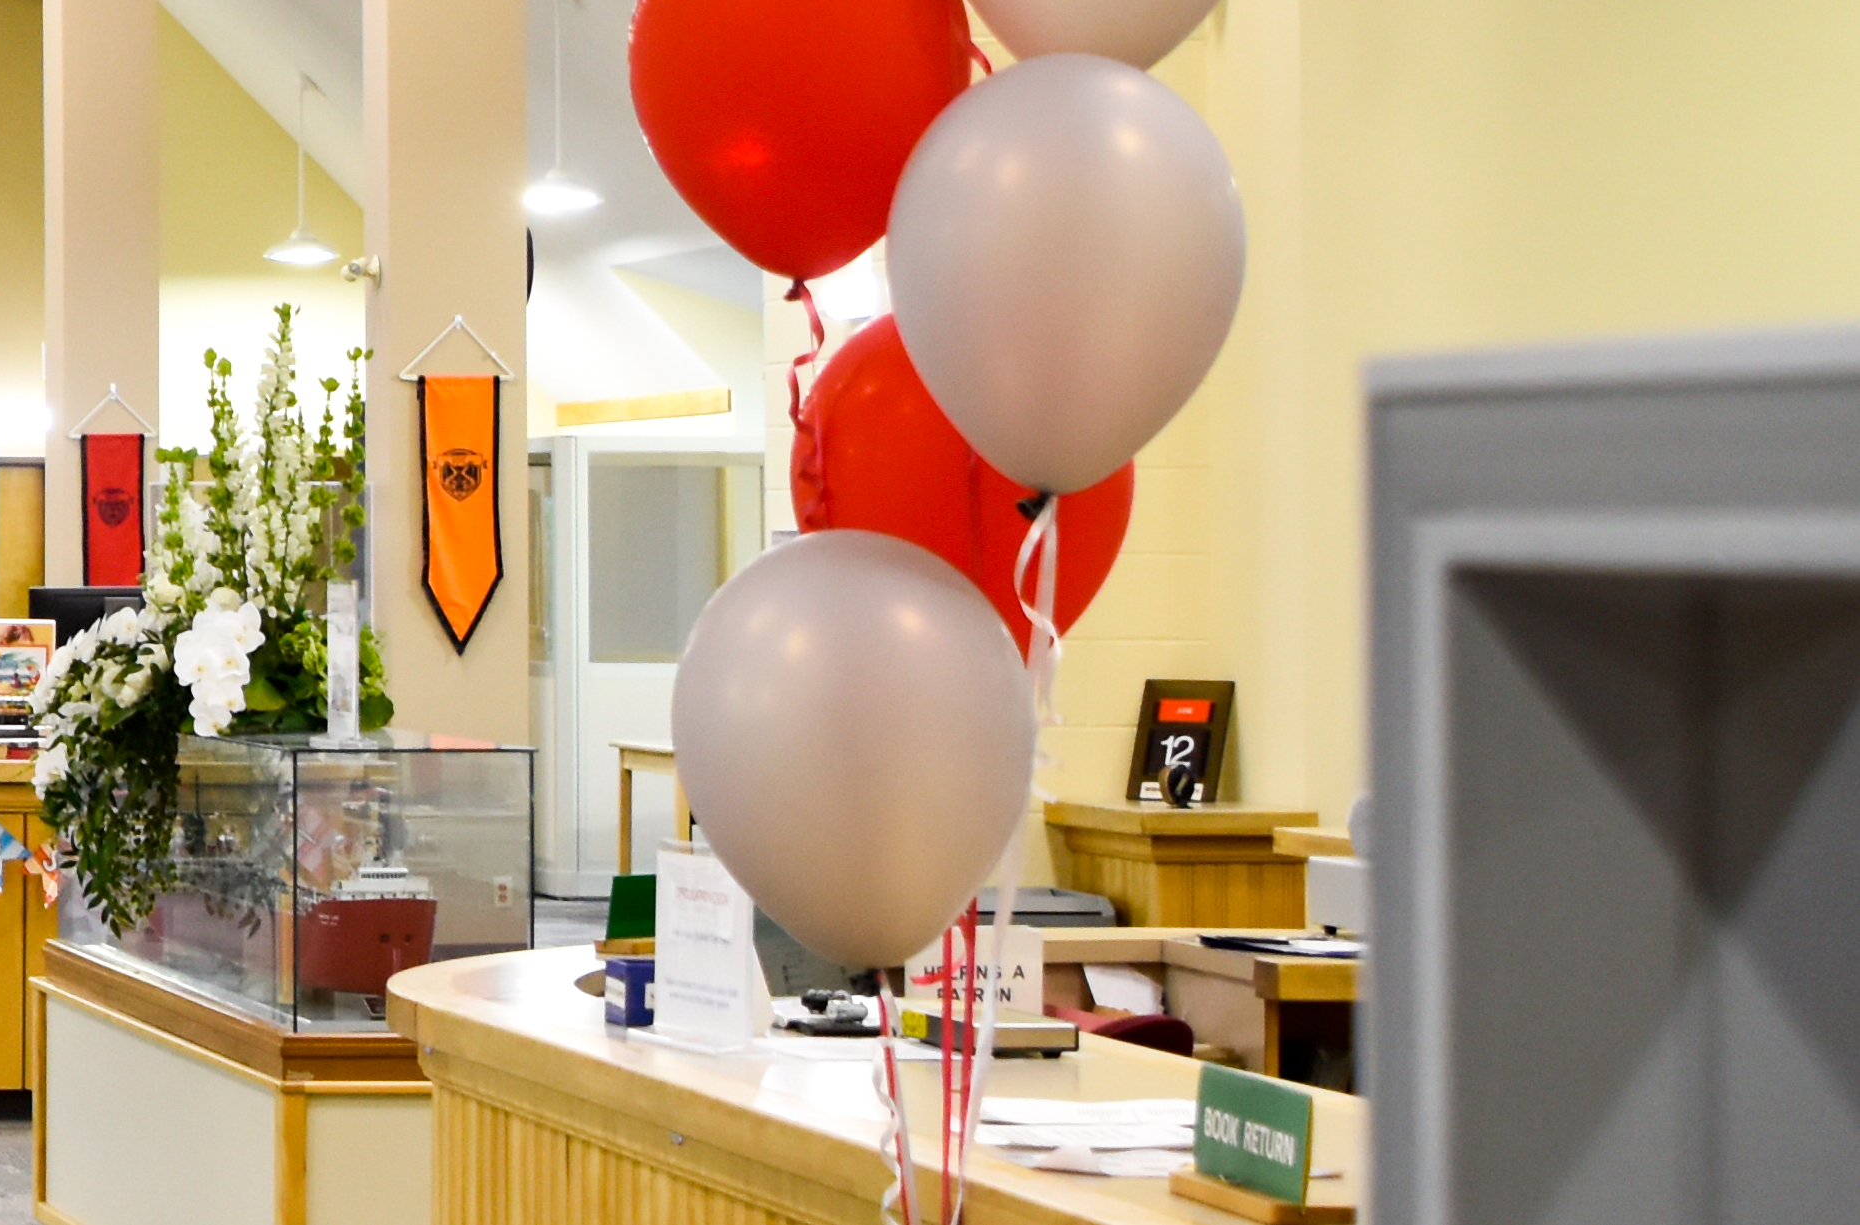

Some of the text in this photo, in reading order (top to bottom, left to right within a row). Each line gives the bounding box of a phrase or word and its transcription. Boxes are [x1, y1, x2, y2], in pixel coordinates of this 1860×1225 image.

[1160, 735, 1195, 766] 12
[1012, 964, 1025, 980] A
[1203, 1106, 1296, 1168] BOOK RETURN
